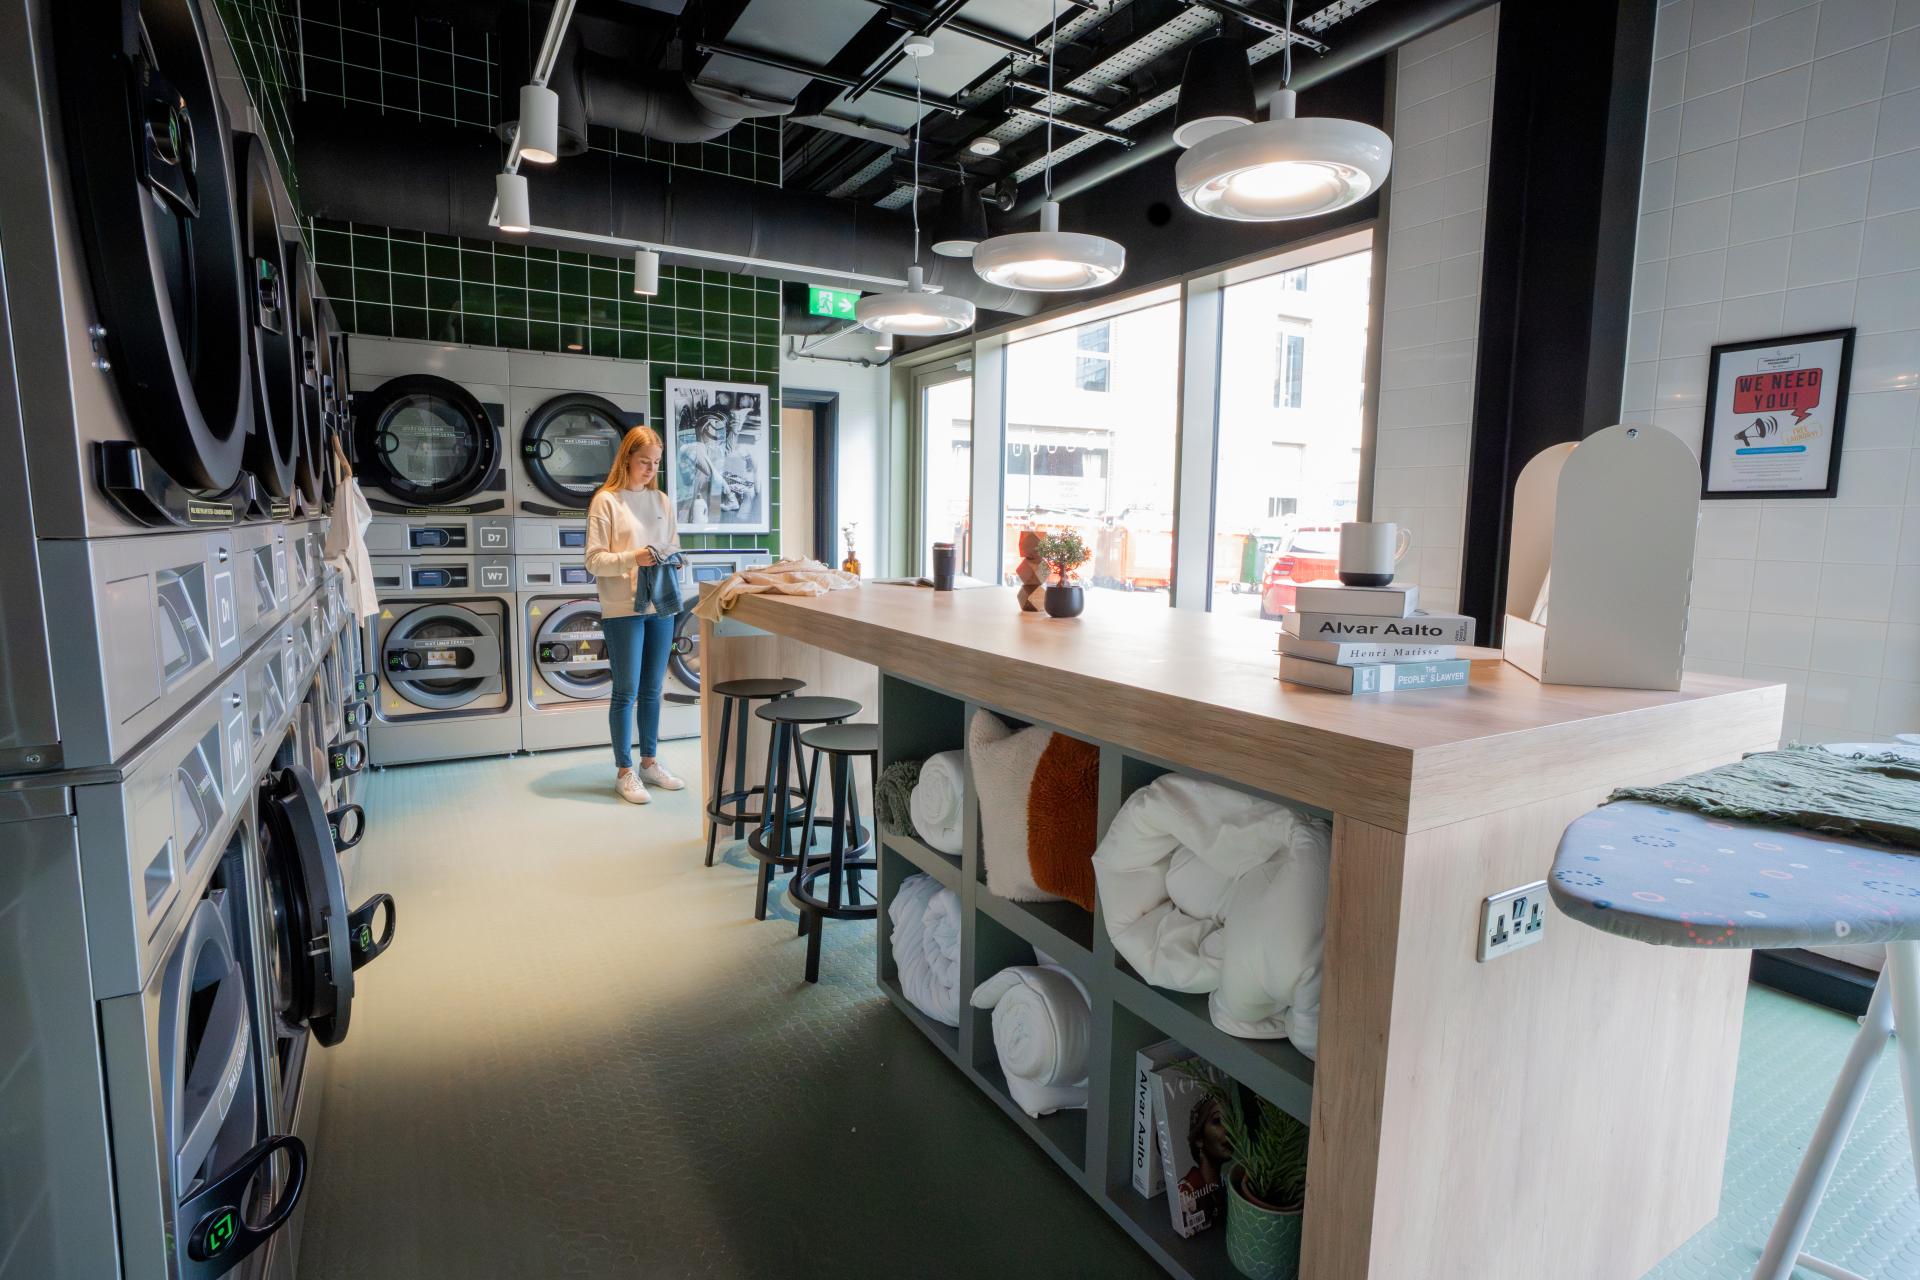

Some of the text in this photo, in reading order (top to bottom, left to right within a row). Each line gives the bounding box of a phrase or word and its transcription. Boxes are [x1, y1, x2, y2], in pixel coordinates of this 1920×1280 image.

[1740, 371, 1818, 393] WE NEED
[1754, 392, 1798, 410] YOU!
[487, 533, 501, 542] D7
[487, 572, 504, 581] W7
[221, 598, 231, 623] D1
[1319, 621, 1443, 637] Alvar Aalto
[1349, 647, 1440, 658] Henri Matisse
[1425, 665, 1437, 673] THE
[1436, 672, 1464, 683] LAWYER
[232, 739, 242, 768] W1
[1140, 1070, 1148, 1119] Alvar
[1137, 1121, 1146, 1168] Aalto
